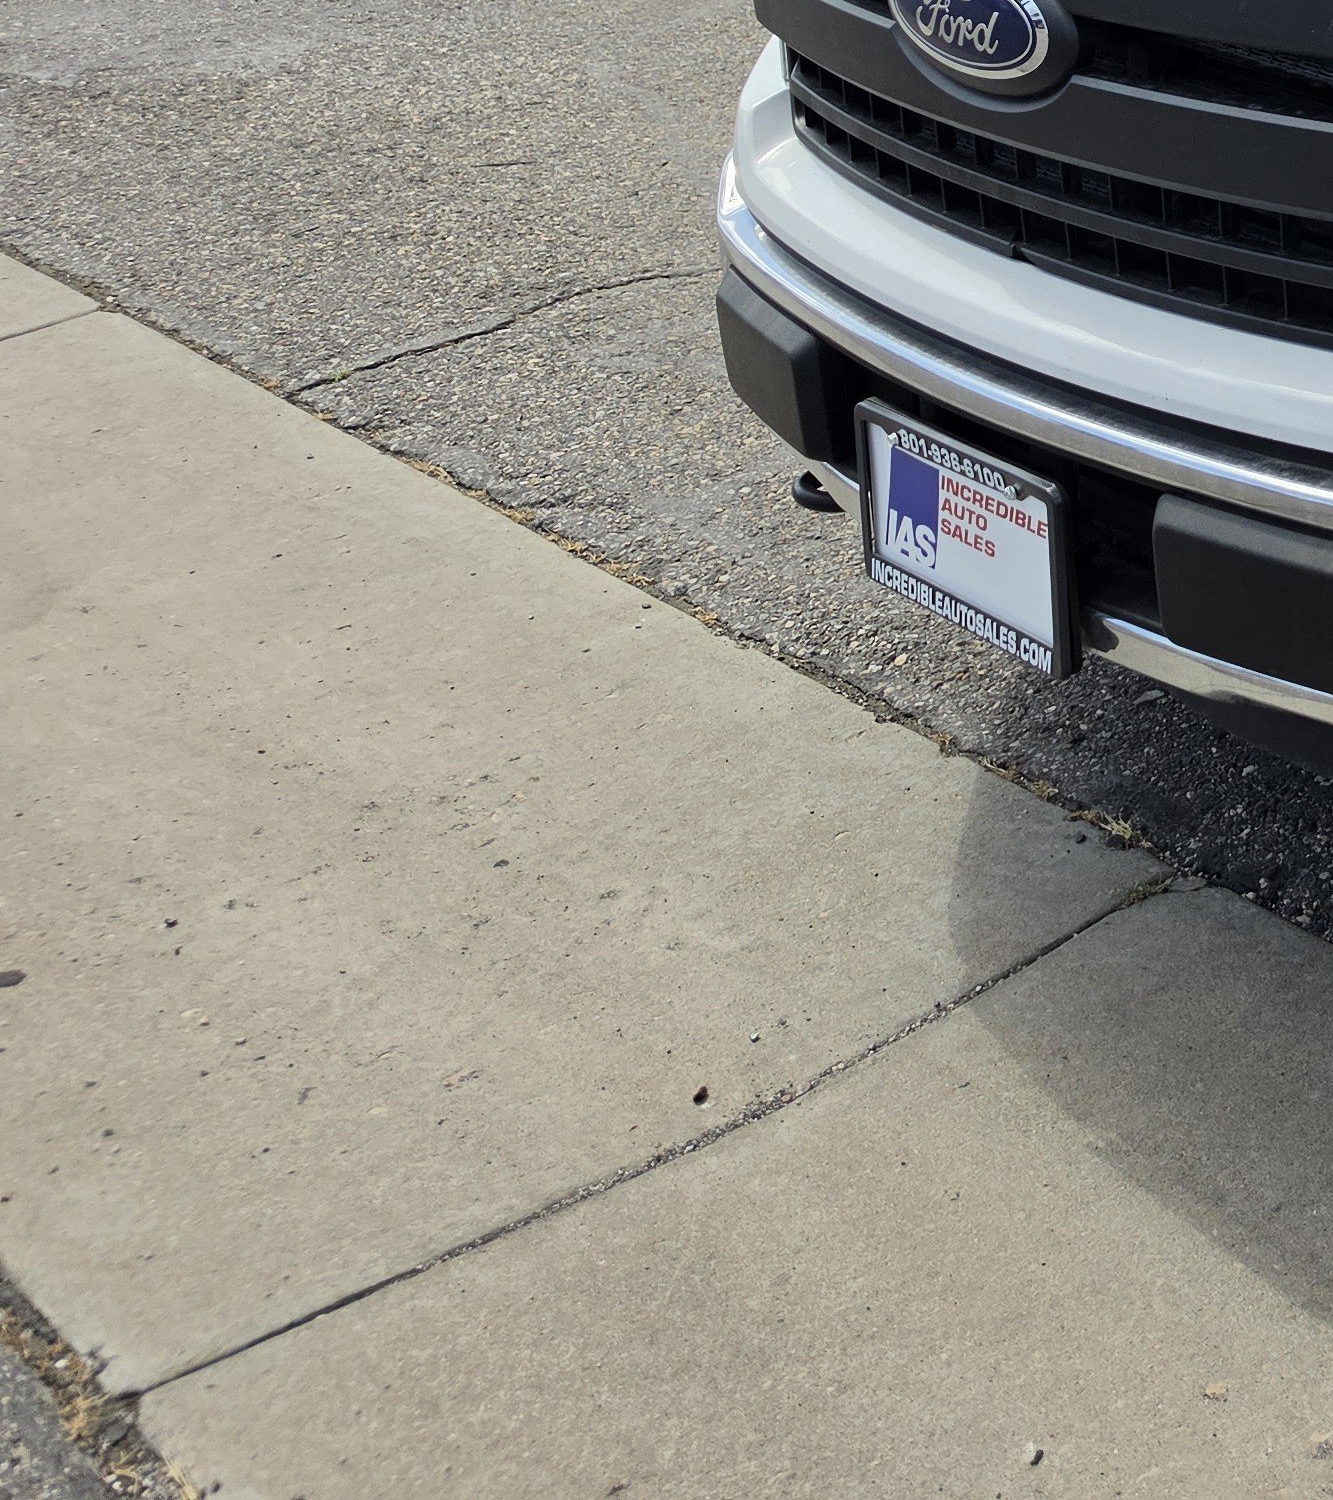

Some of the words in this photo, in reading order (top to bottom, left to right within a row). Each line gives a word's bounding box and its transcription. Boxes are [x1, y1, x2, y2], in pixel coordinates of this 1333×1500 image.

[899, 428, 1005, 490] 801-936-6100
[940, 474, 1049, 540] INCREDIBLE
[940, 497, 989, 532] AUTO
[885, 508, 937, 570] IAS
[940, 519, 997, 559] SALES
[870, 557, 1053, 676] INCREDIBLEAUTOSALES.COM
